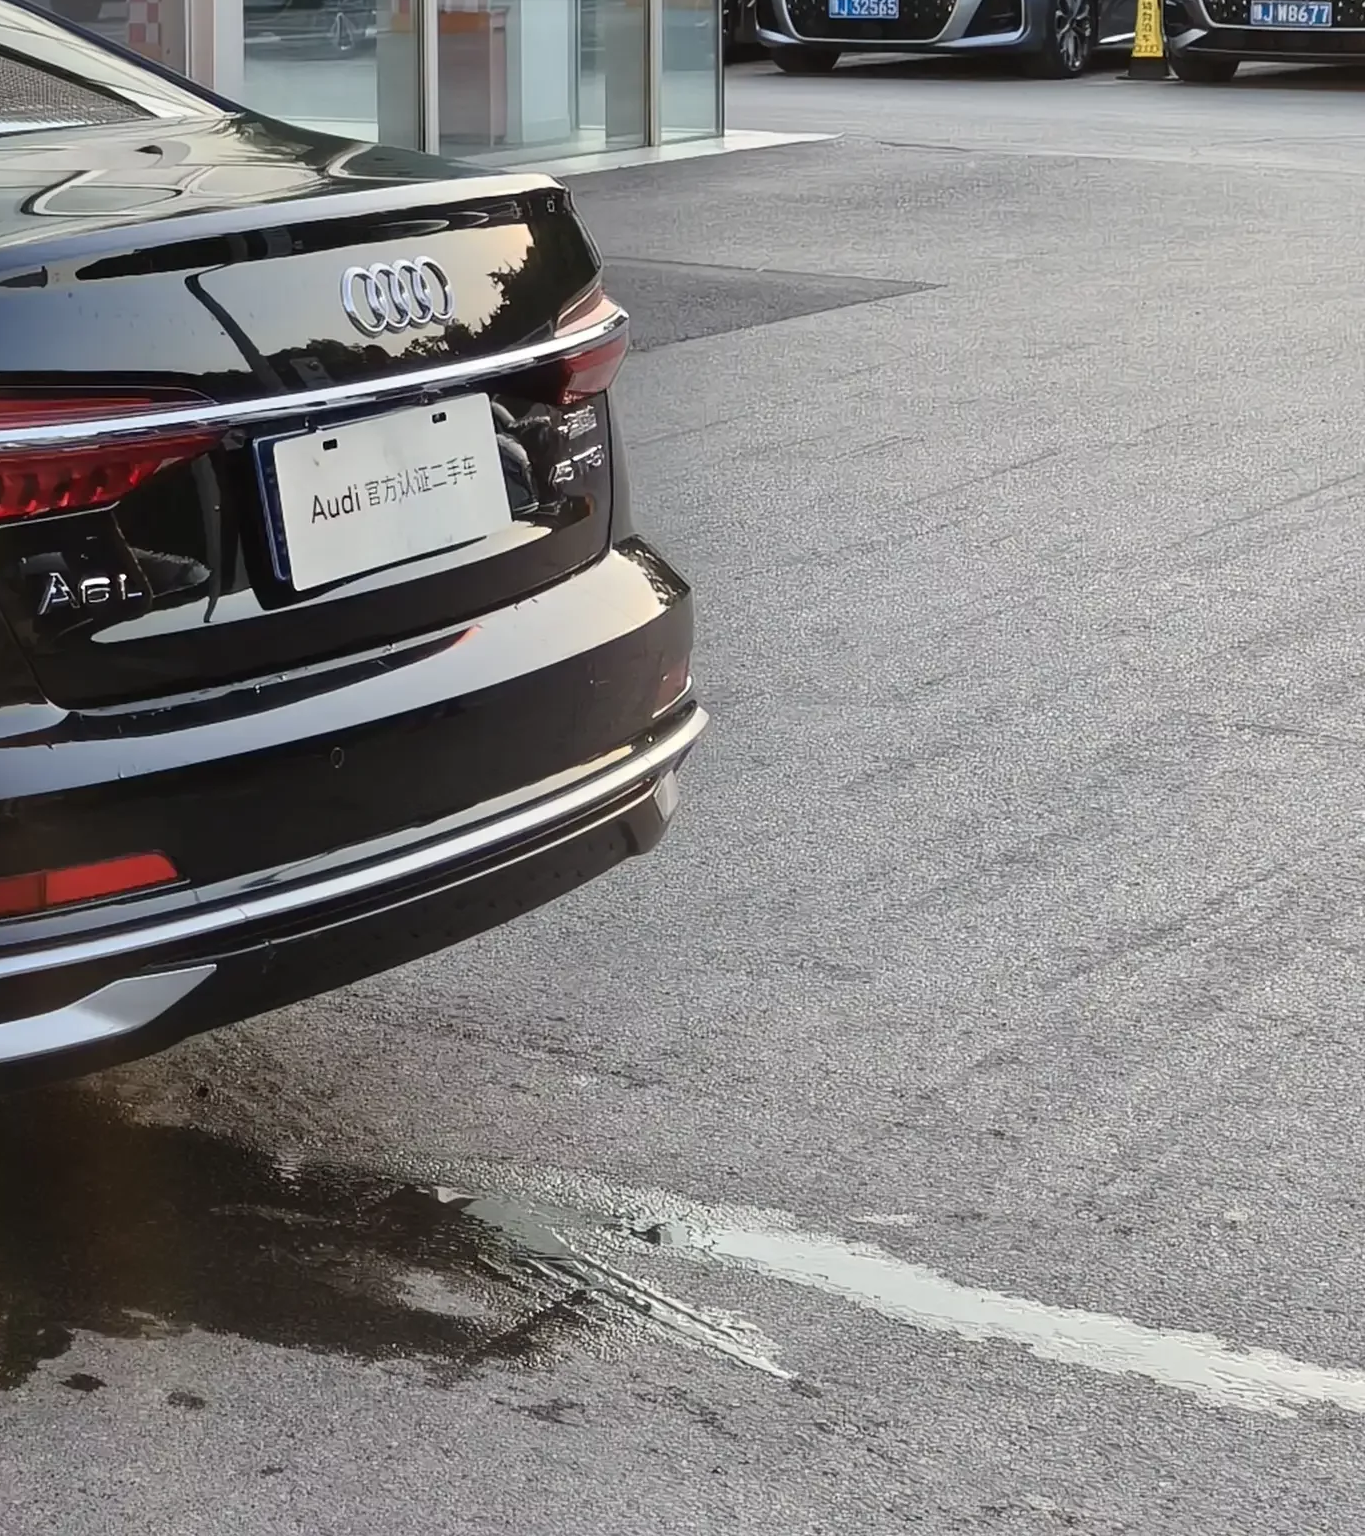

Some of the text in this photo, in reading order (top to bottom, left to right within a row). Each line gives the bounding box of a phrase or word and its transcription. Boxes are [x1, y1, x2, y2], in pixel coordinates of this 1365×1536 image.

[311, 455, 478, 524] Audi 官方认证二手车
[37, 571, 143, 616] A6L
